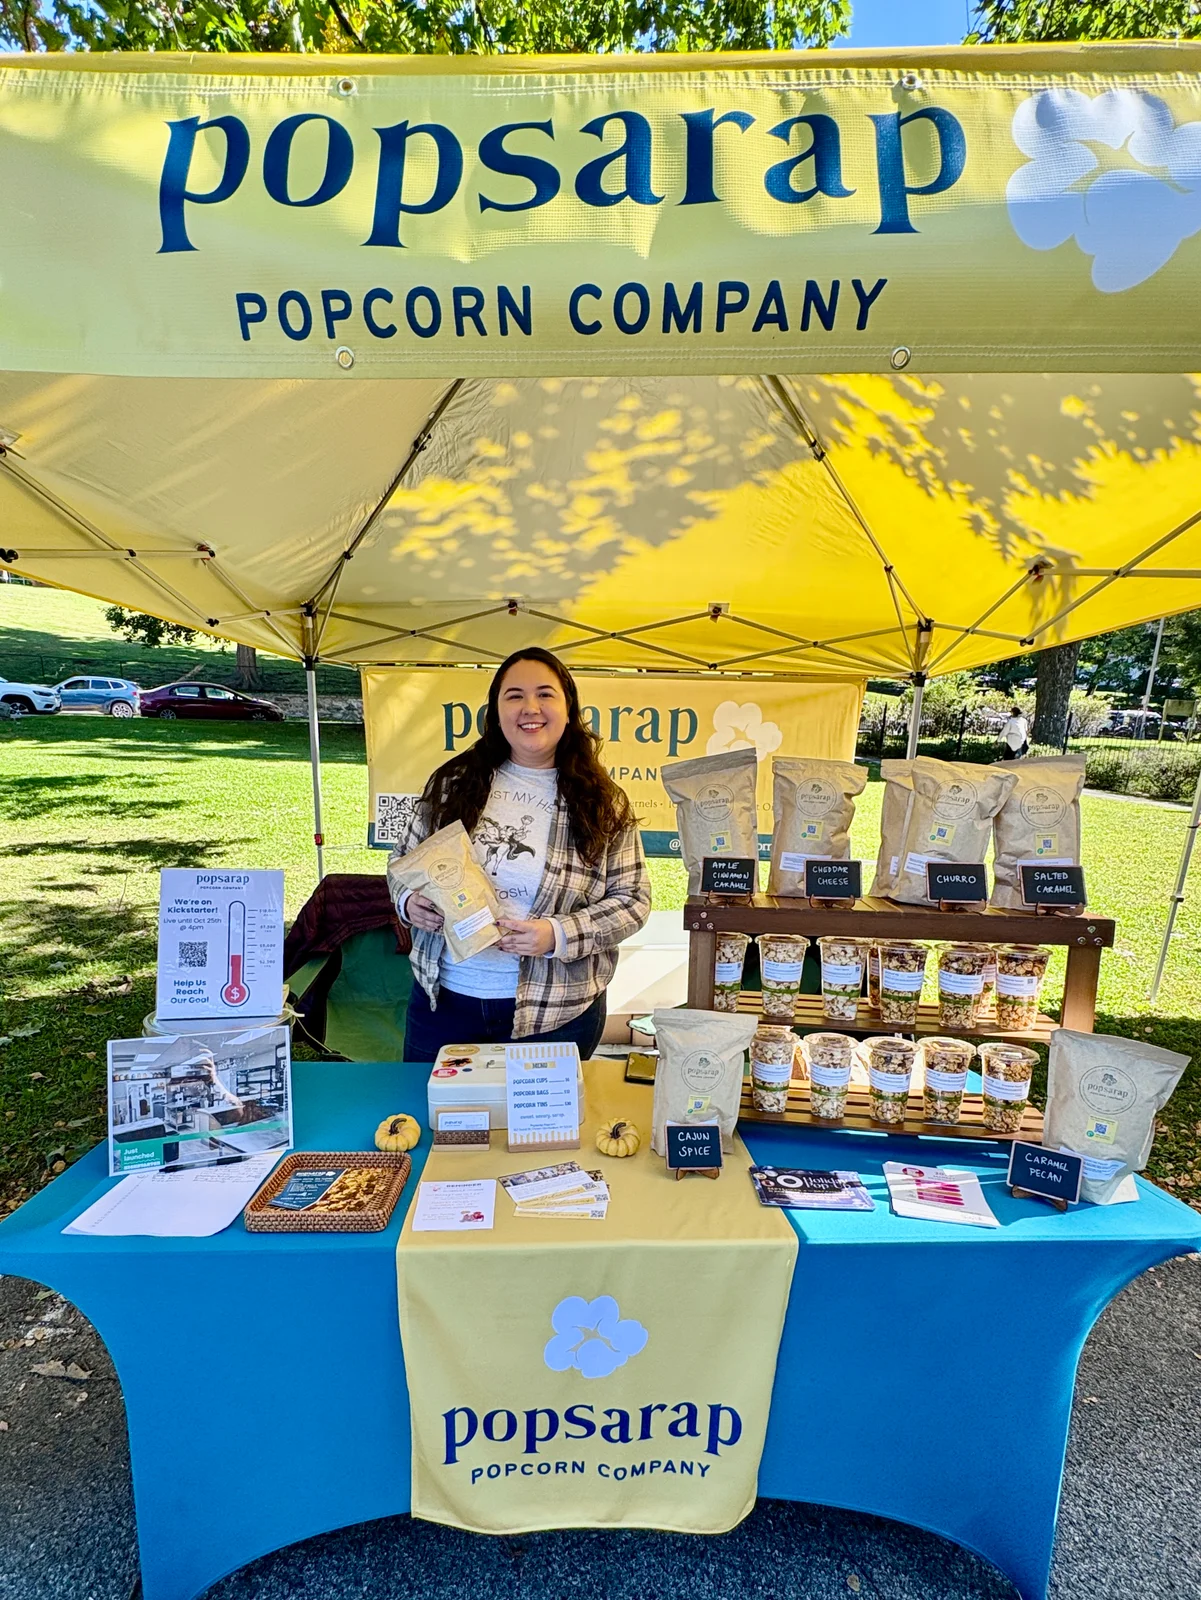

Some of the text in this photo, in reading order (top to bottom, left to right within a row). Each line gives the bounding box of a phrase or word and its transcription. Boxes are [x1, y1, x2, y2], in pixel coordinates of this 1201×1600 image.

[156, 106, 966, 254] popsarap
[236, 278, 888, 341] POPCORN COMPANY
[512, 791, 536, 804] MY
[712, 861, 739, 869] APPLE
[812, 865, 849, 873] CHEDDAR
[196, 874, 250, 886] popsarap
[712, 871, 749, 879] CINNAMON
[936, 874, 977, 884] CHURRO
[1034, 872, 1069, 880] SALTED
[714, 881, 751, 890] CARAMEL
[1036, 885, 1076, 894] CARAMEL
[173, 980, 194, 988] Help
[188, 996, 209, 1004] Goal
[687, 1067, 719, 1076] popsarap
[1087, 1083, 1129, 1098] popsarap
[677, 1131, 710, 1142] CAJUN
[123, 1151, 155, 1161] launched
[678, 1146, 711, 1157] SPICE
[1024, 1152, 1070, 1172] CARAMEL
[1029, 1167, 1062, 1183] PECAN
[441, 1401, 743, 1465] popsarap
[471, 1458, 711, 1485] POPCORN COMPANY
